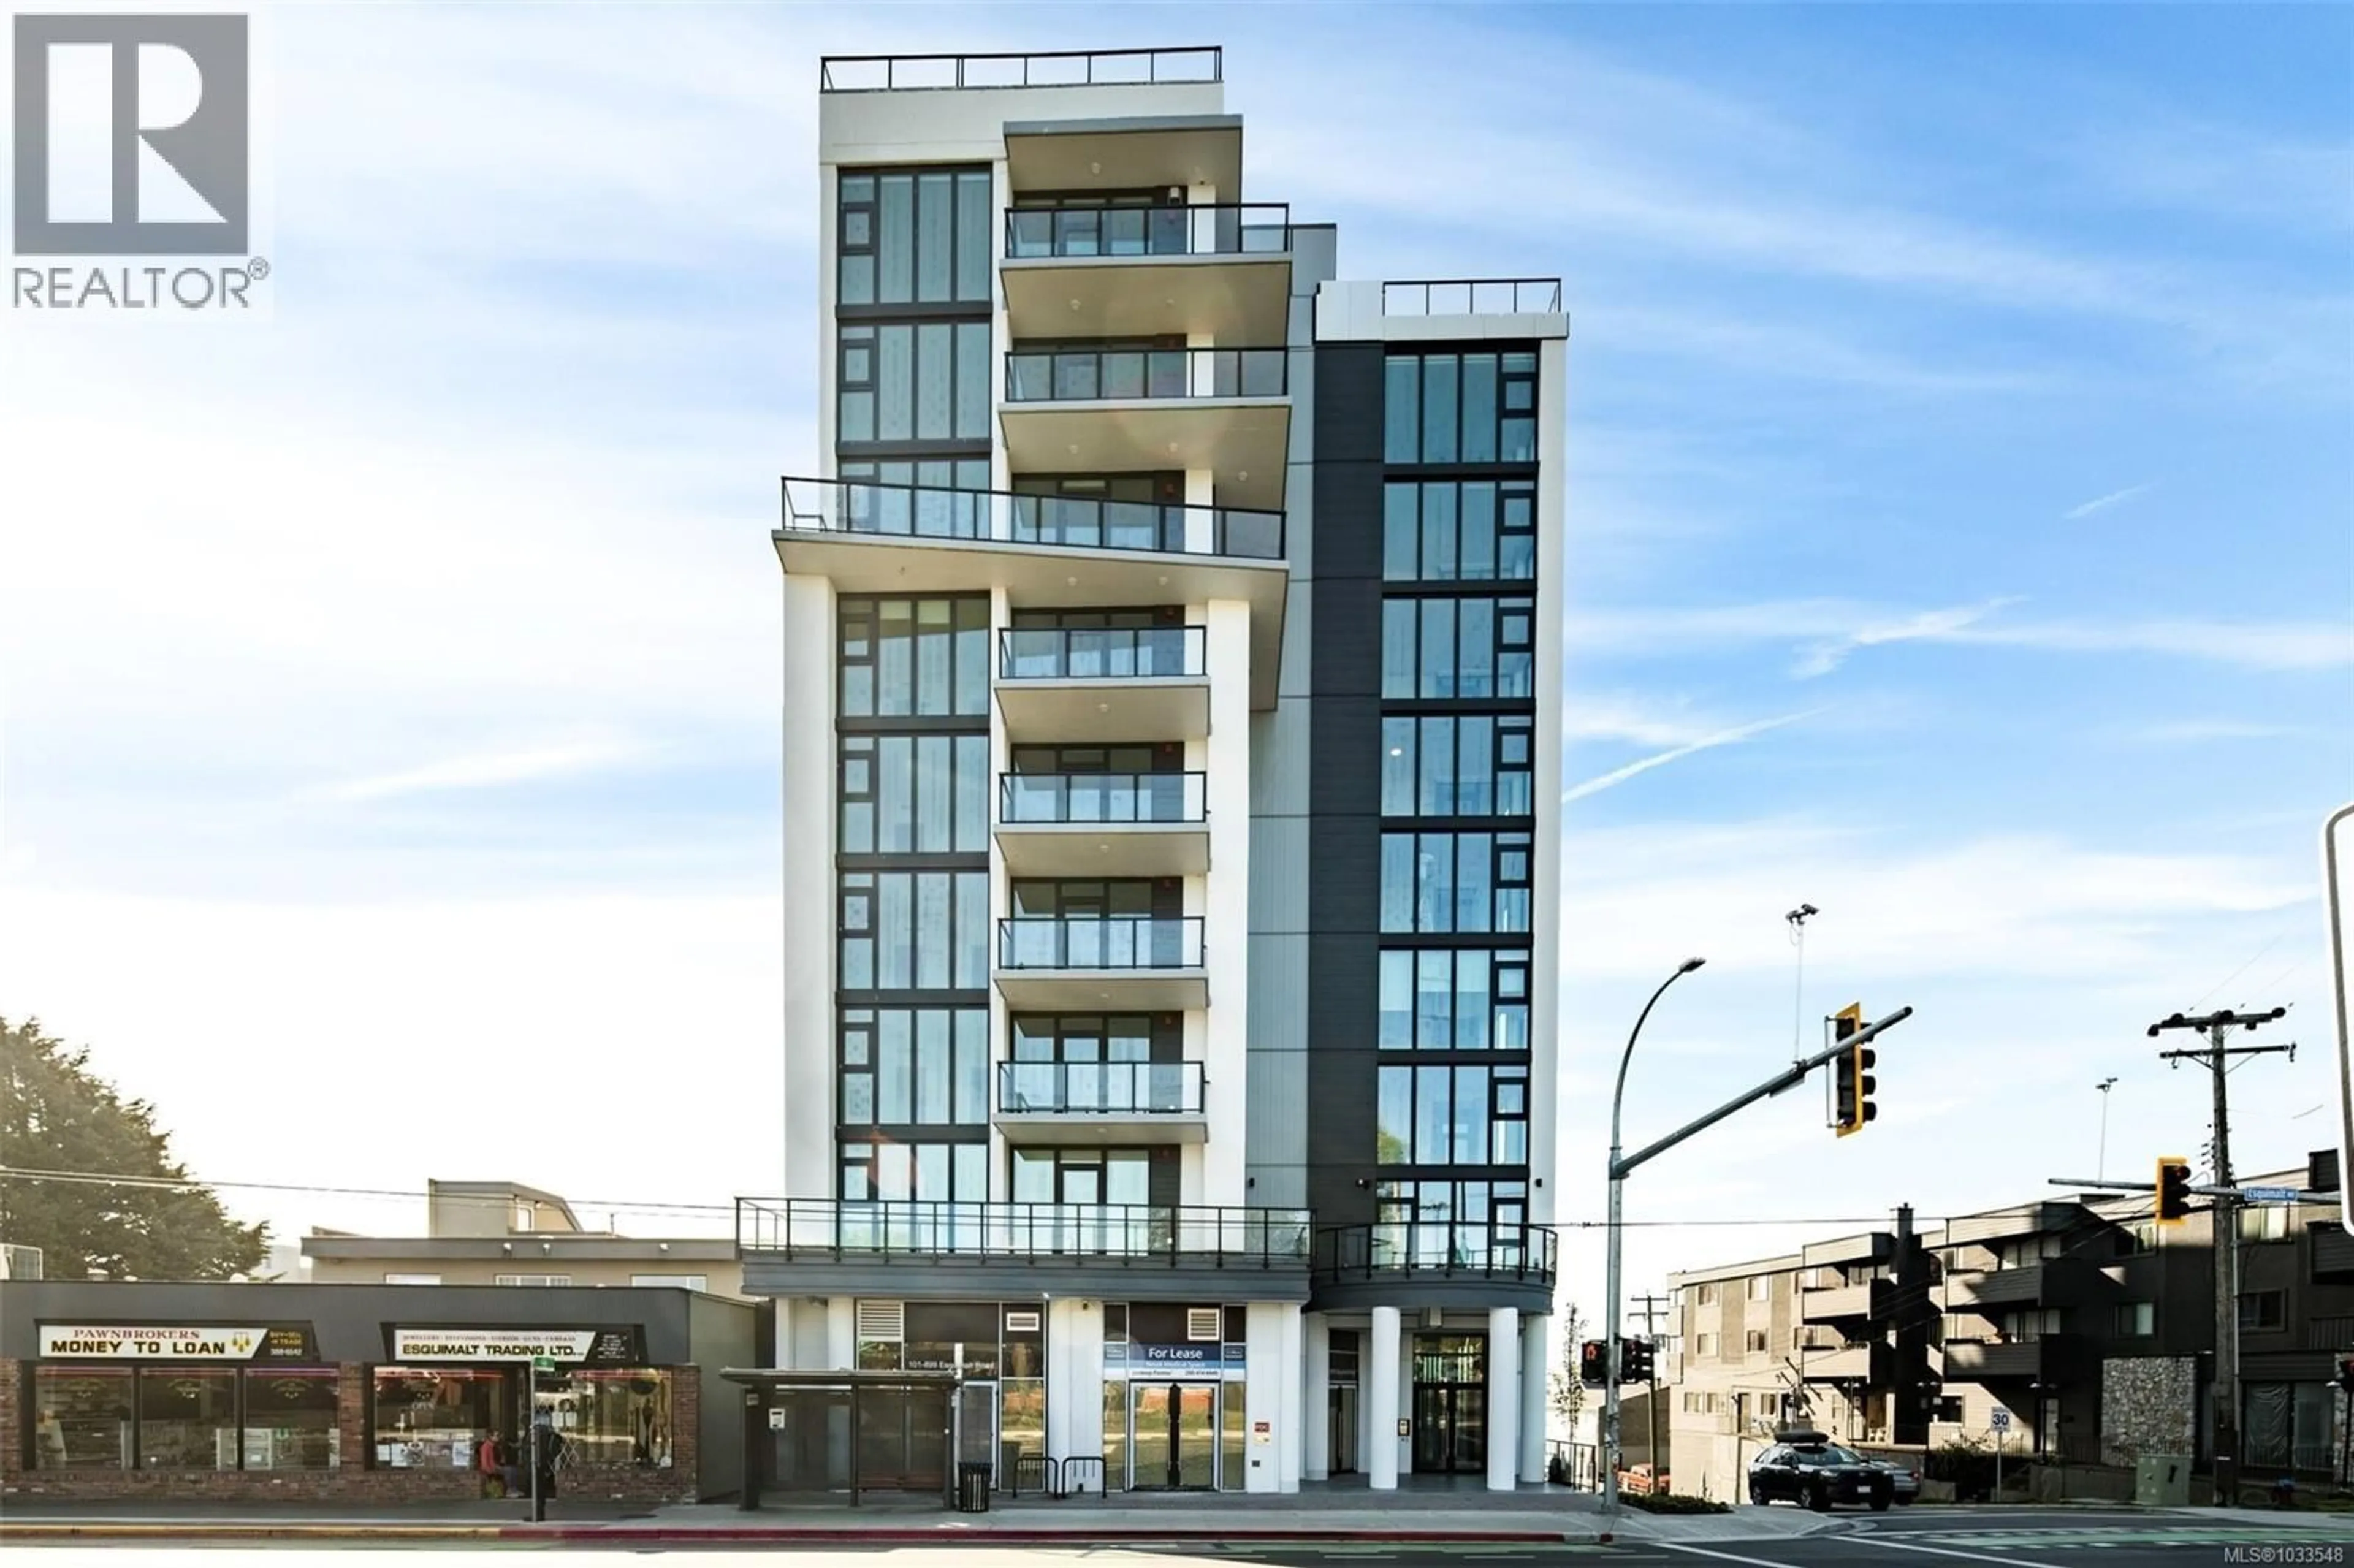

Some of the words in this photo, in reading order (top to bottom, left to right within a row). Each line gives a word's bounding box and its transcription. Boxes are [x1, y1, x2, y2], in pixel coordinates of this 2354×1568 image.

[74, 1329, 200, 1339] PAWNBROKERS
[51, 1341, 122, 1353] MONEY
[134, 1342, 160, 1353] TO
[172, 1342, 225, 1354] LOAN
[403, 1345, 479, 1354] ESQUIMALT
[484, 1345, 544, 1355] TRADING
[1149, 1348, 1167, 1358] For
[1170, 1349, 1203, 1359] Lease
[1993, 1414, 2009, 1425] 30
